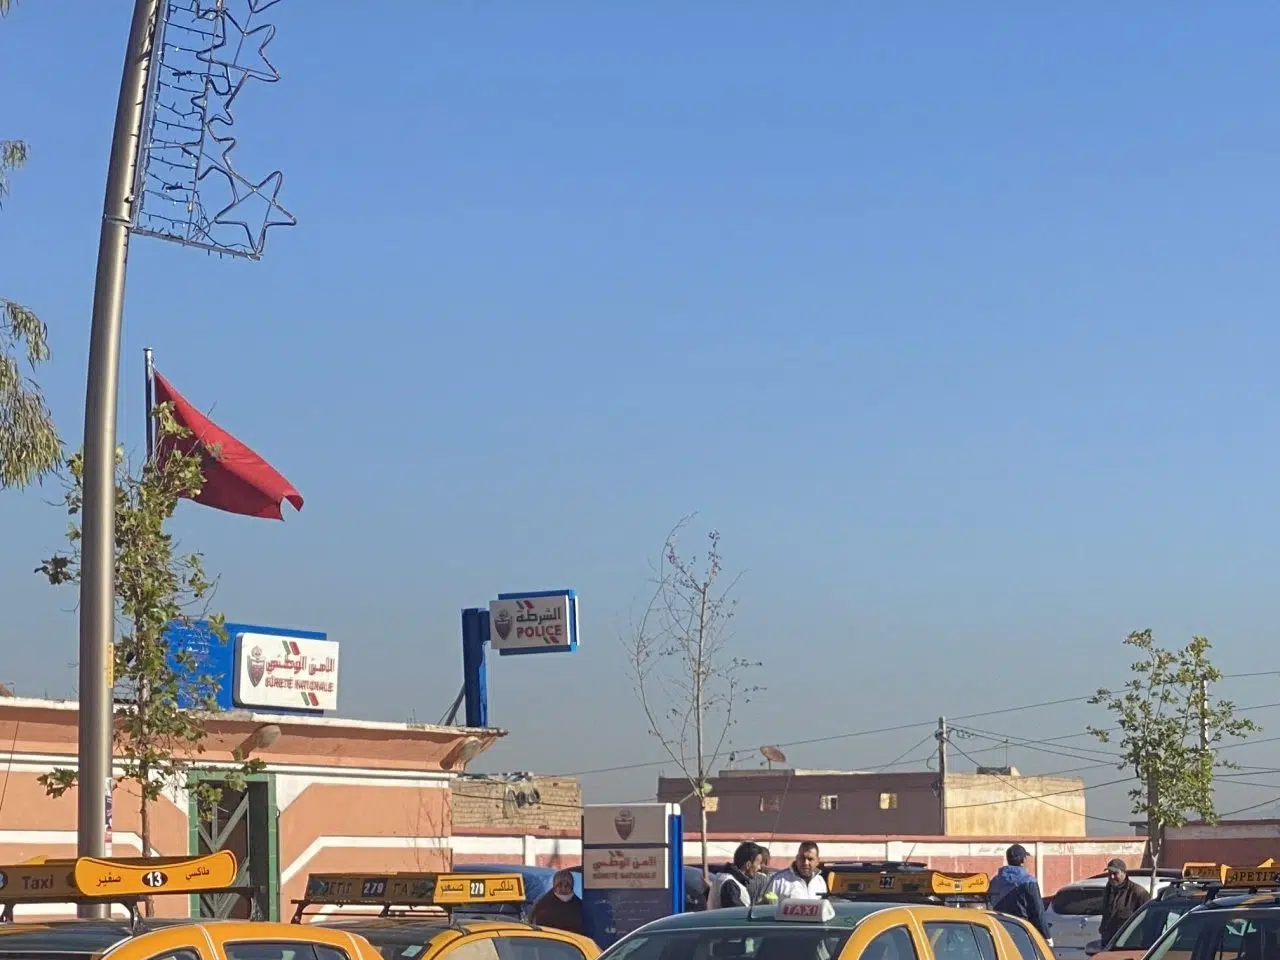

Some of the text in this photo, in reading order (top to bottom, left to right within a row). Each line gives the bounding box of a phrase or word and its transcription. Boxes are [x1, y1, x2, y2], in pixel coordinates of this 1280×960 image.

[516, 607, 561, 625] الشرطة
[516, 625, 562, 638] POLICE
[265, 653, 307, 675] الوطني
[294, 679, 334, 693] NATIONALE
[21, 874, 54, 890] Taxi
[96, 867, 210, 887] طاكسي 13 صغير
[363, 881, 384, 894] 279
[784, 903, 818, 917] TAXI
